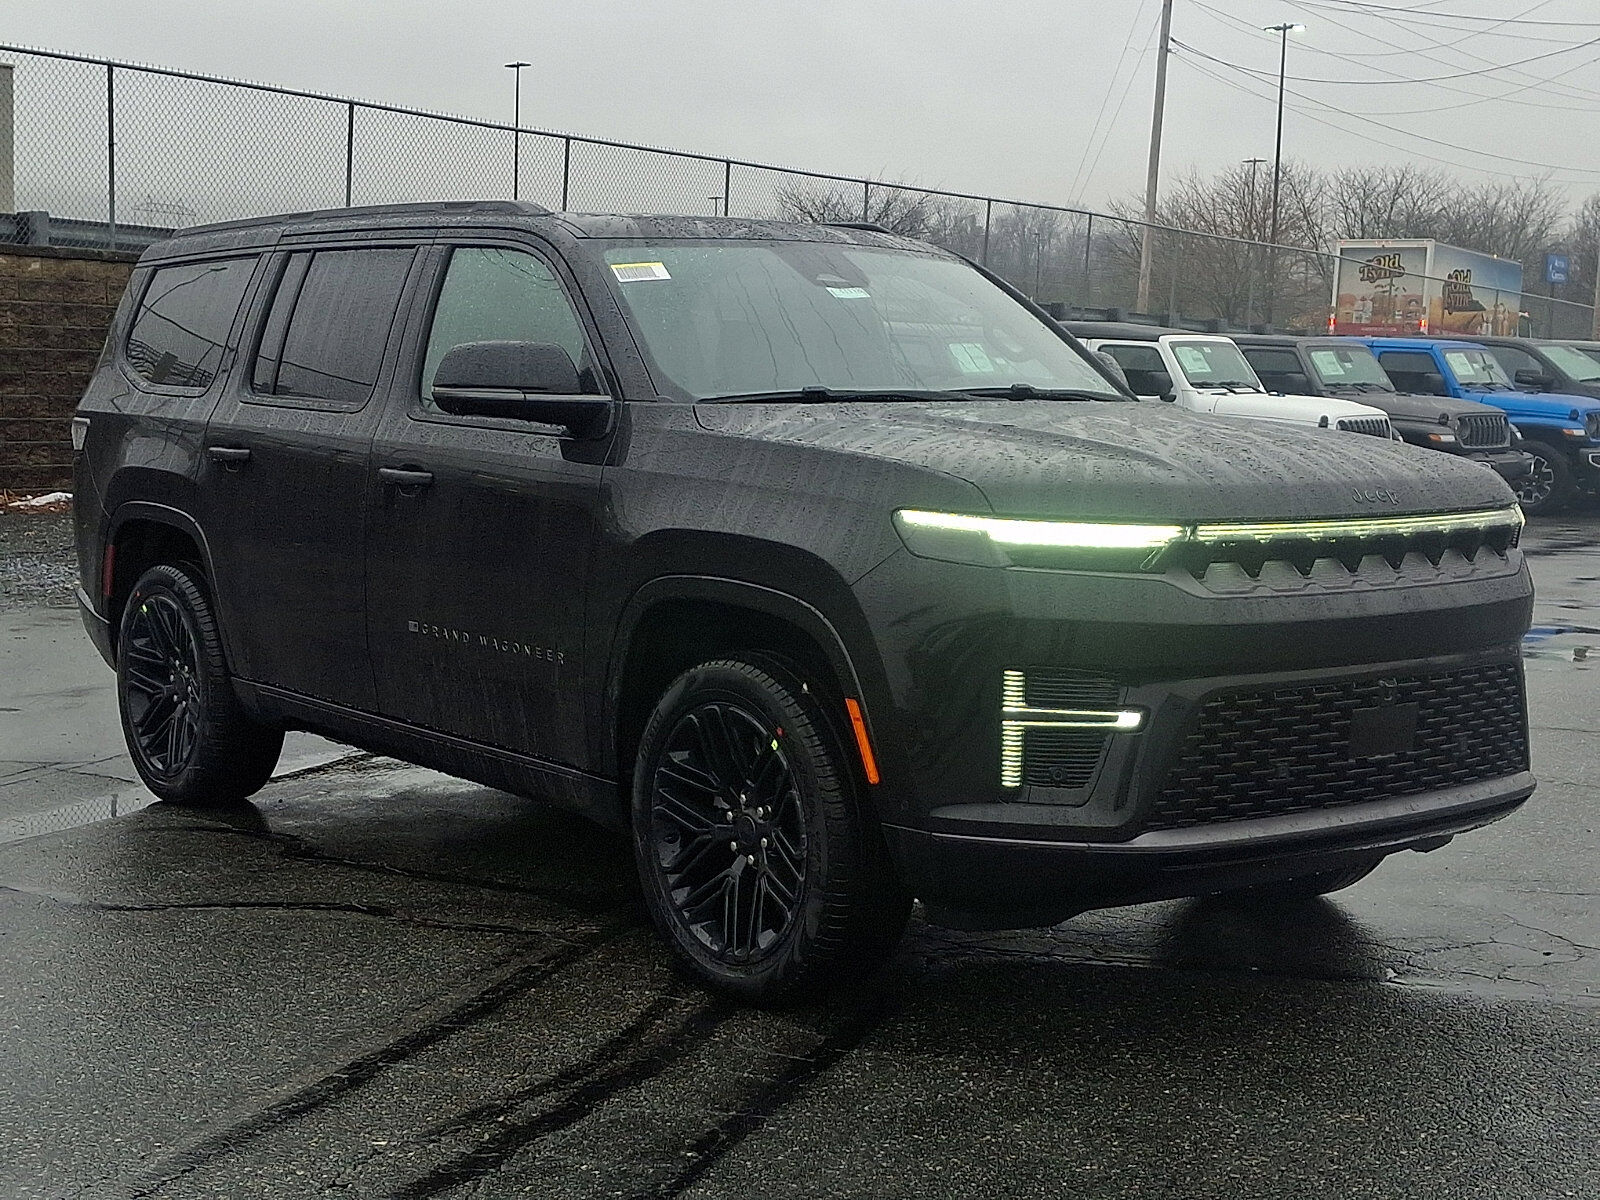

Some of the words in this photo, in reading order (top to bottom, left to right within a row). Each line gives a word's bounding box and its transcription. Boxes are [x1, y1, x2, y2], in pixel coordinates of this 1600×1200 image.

[1372, 253, 1401, 268] Old
[1352, 487, 1400, 505] Jeep
[421, 623, 469, 644] GRAND
[479, 634, 564, 665] WAGONEER
